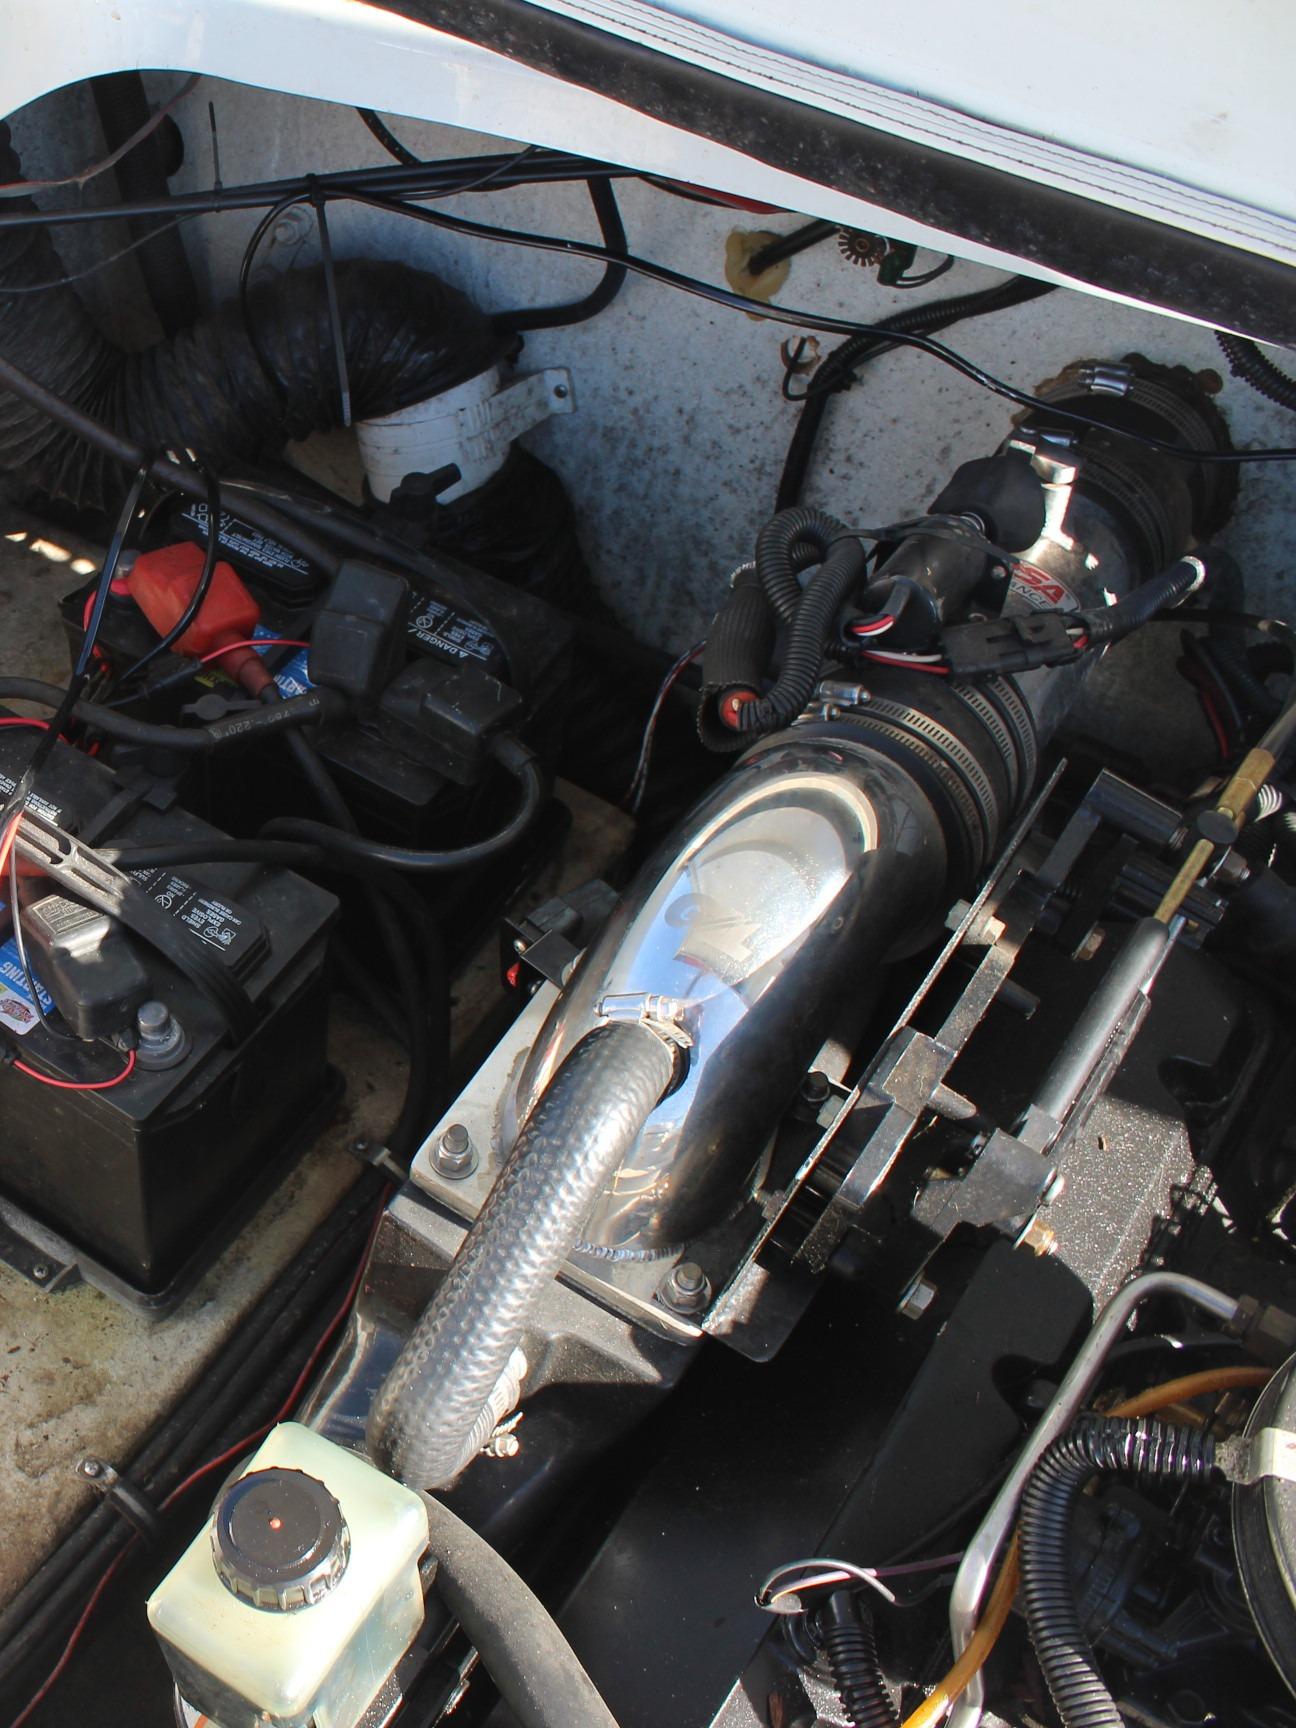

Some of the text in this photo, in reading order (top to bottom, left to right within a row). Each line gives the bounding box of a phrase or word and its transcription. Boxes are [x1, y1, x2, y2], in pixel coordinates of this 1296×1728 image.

[415, 630, 457, 654] DANGER
[181, 913, 200, 928] SHIELD
[189, 912, 205, 924] EYES
[191, 906, 220, 926] EXPLOSIVE
[205, 908, 225, 922] GASES
